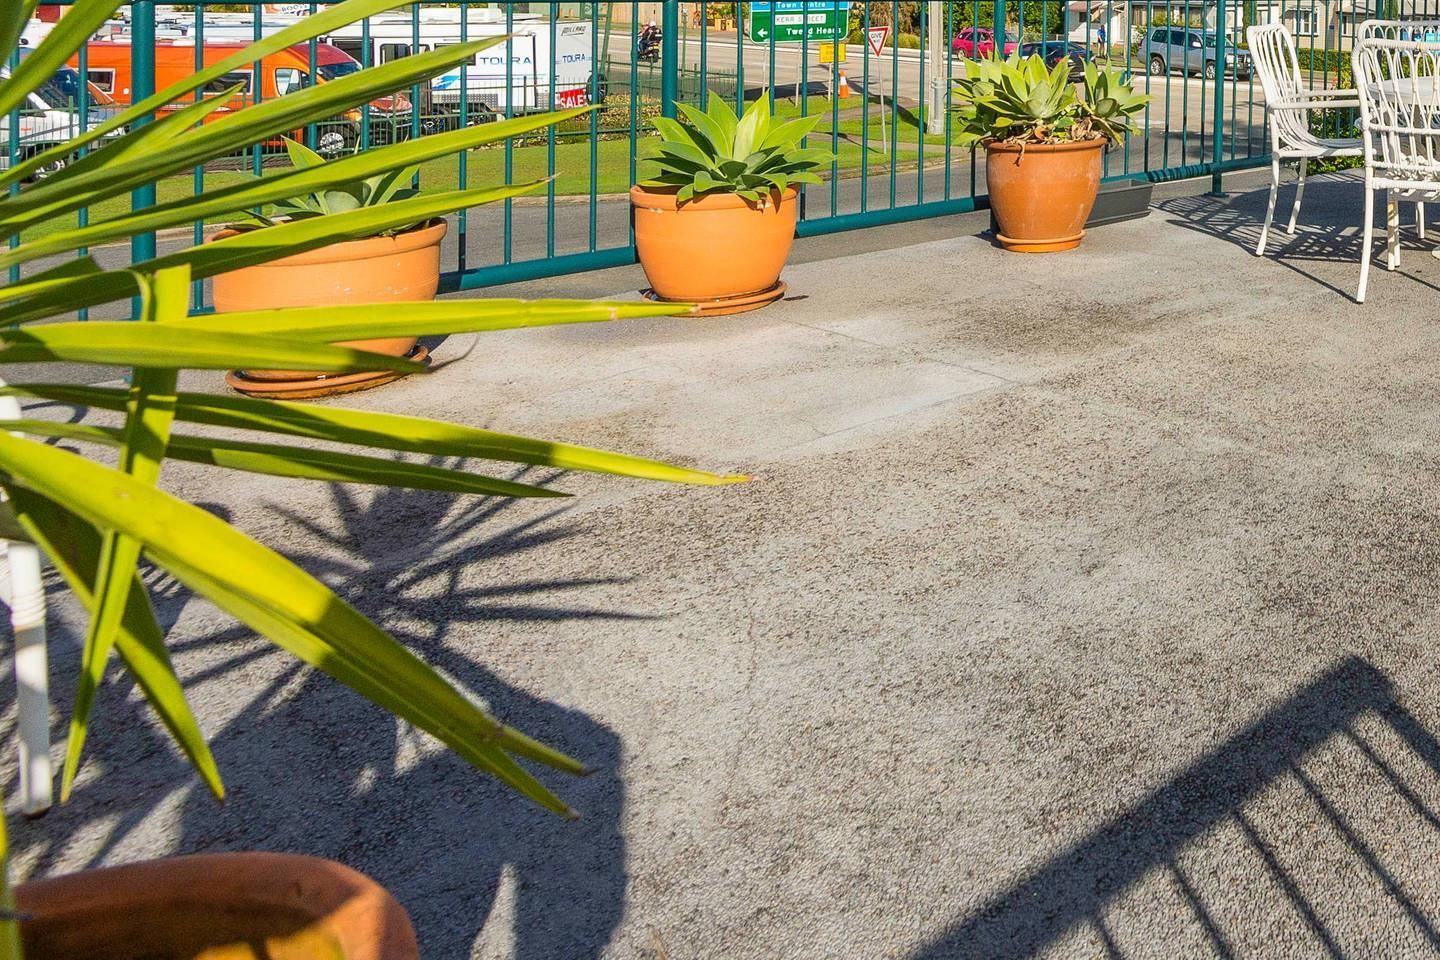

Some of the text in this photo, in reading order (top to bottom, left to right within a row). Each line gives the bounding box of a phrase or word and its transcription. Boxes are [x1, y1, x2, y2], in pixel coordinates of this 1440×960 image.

[786, 27, 841, 35] Twed Heas
[562, 54, 586, 63] TOURA
